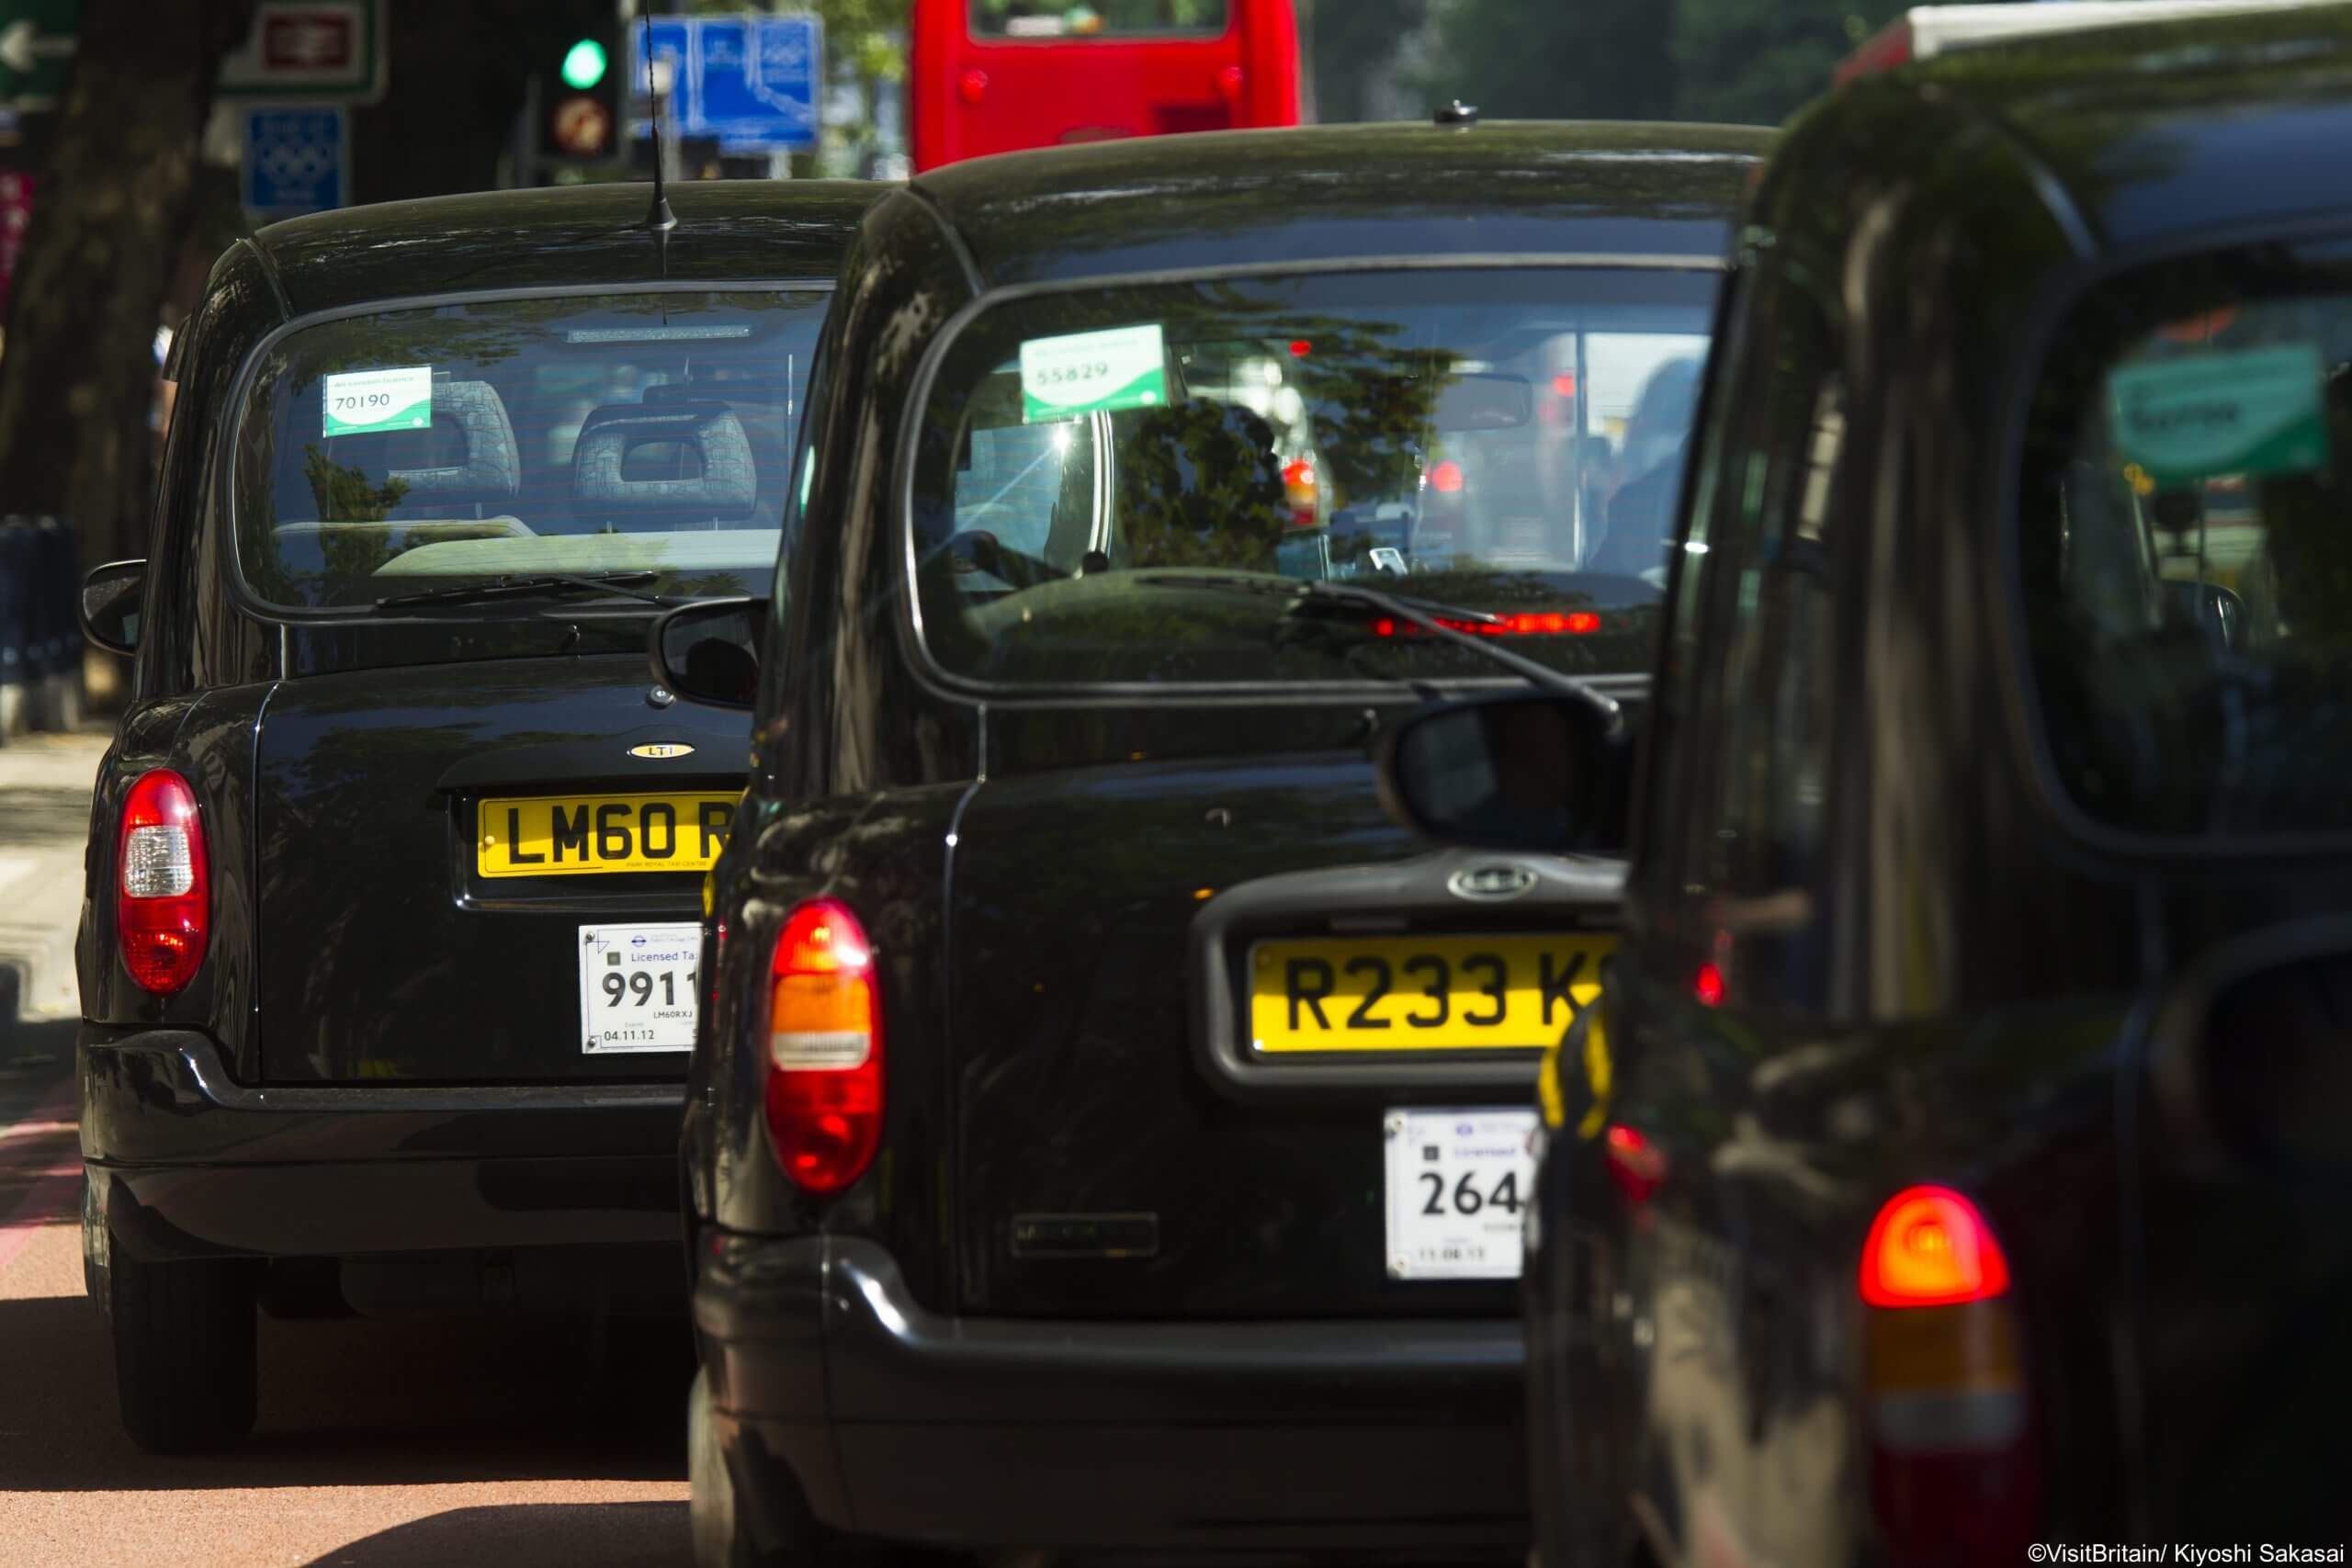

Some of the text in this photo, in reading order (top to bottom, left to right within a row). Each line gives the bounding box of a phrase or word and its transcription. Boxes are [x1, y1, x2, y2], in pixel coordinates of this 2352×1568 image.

[1036, 361, 1108, 386] 55829
[335, 393, 390, 411] 70190
[508, 803, 676, 864] LM60
[631, 950, 698, 962] Licensed Ta
[1286, 953, 1608, 1031] R233 K
[653, 1010, 693, 1019] LM60RXJ
[604, 1030, 655, 1041] 04.11.12
[1419, 1170, 1526, 1215] 264
